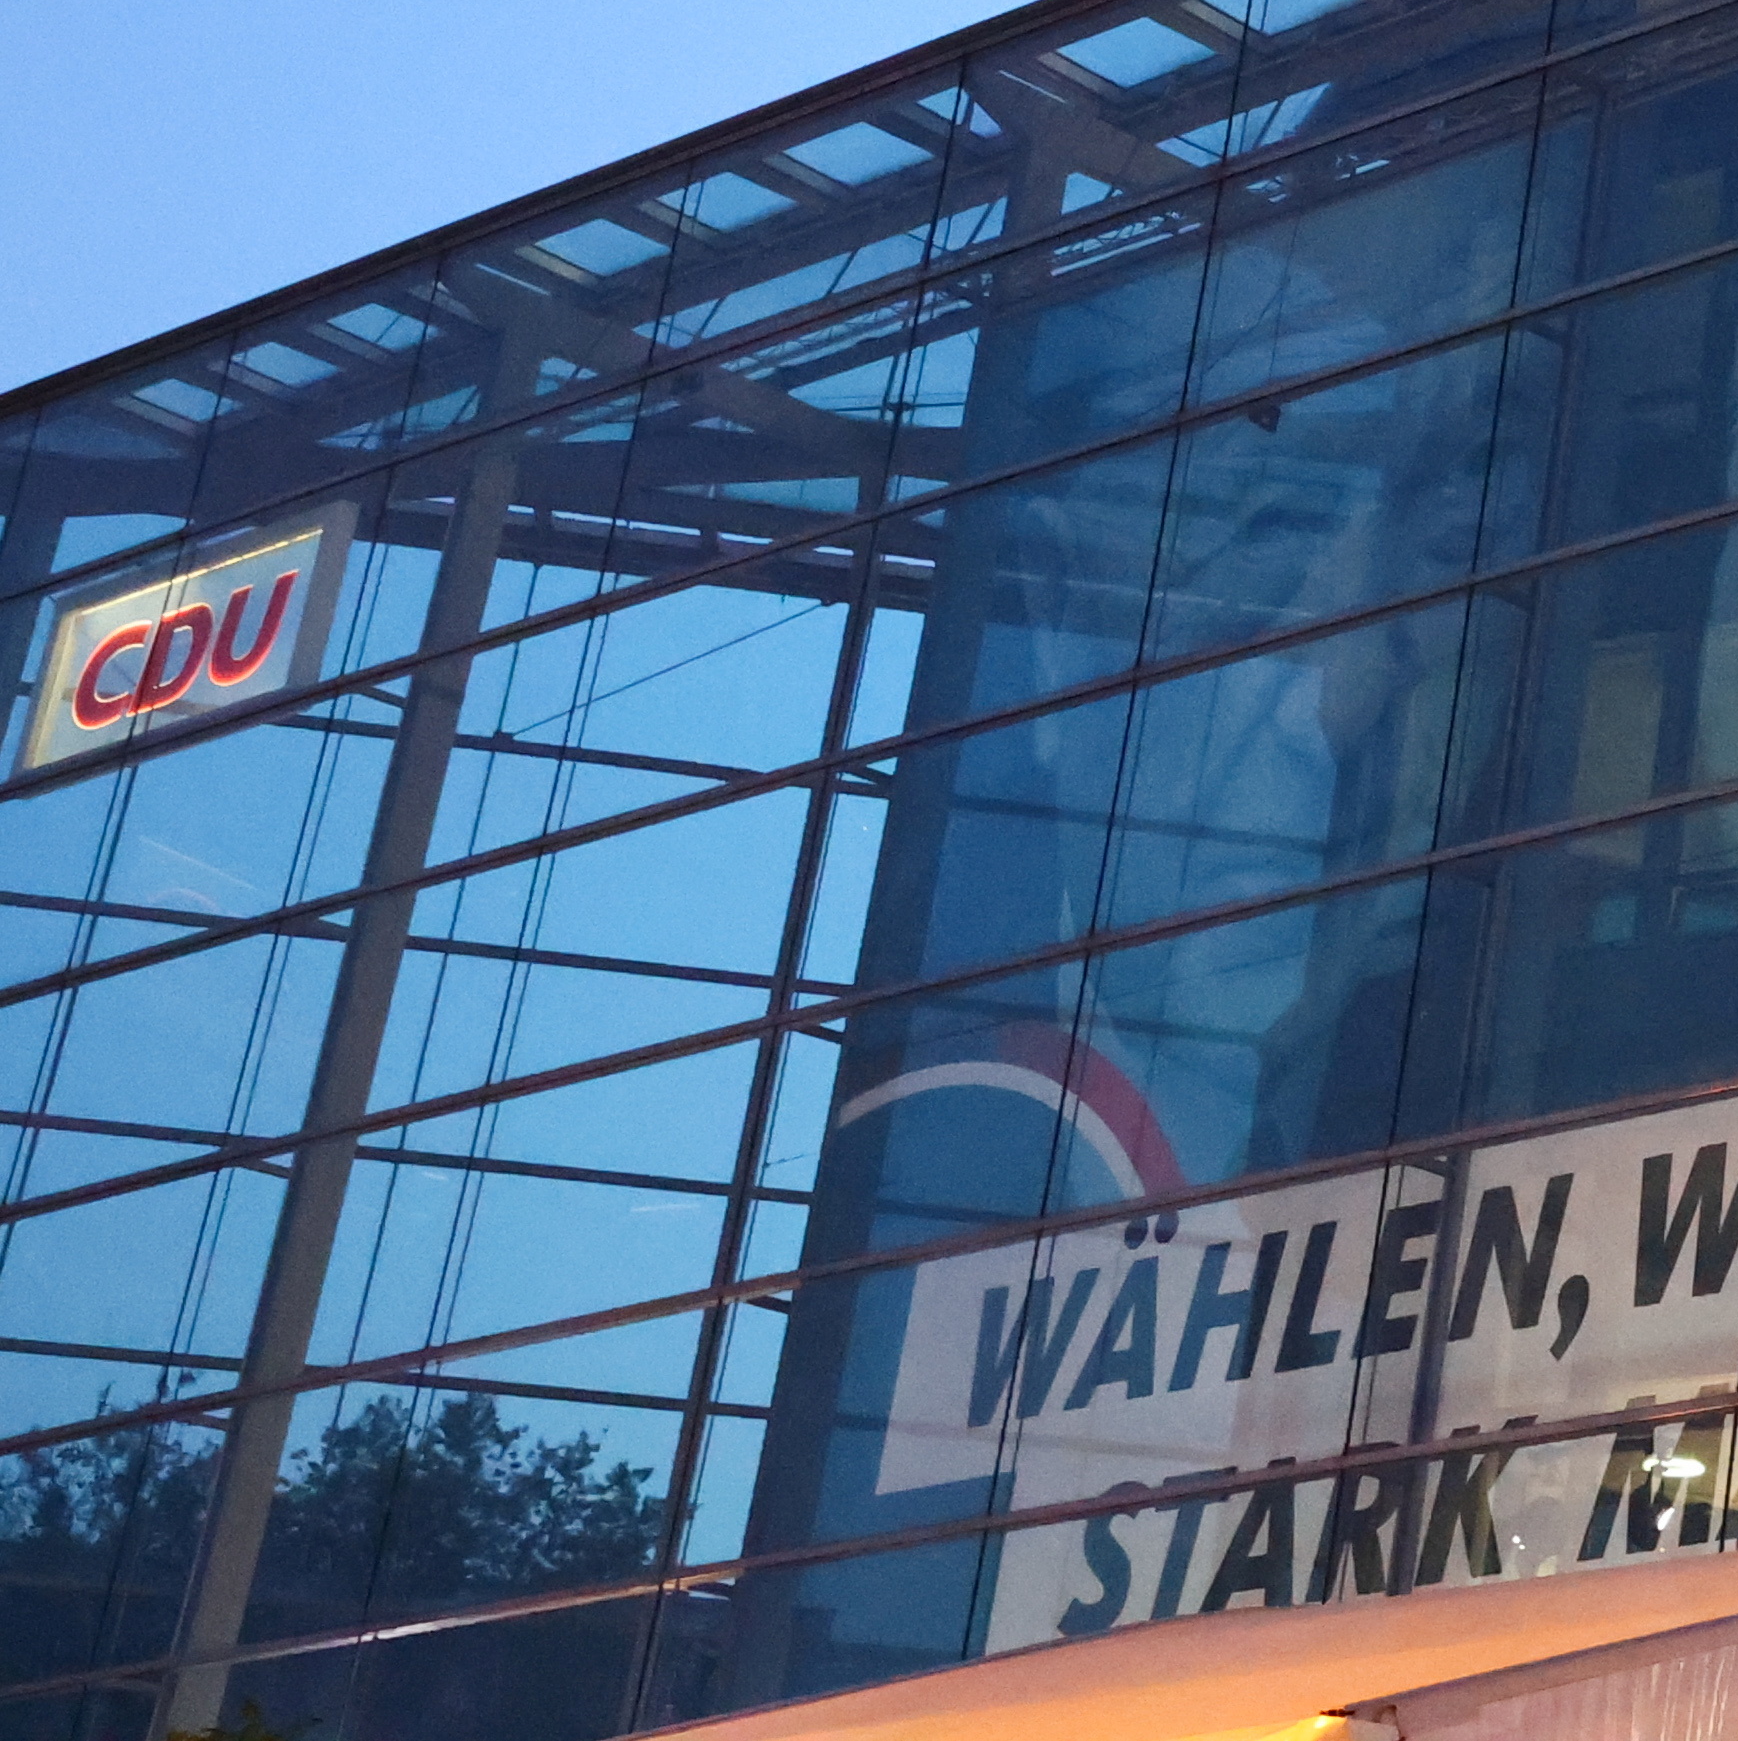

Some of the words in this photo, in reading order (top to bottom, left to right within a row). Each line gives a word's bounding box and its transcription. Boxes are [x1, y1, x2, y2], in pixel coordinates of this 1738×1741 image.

[72, 569, 299, 731] CDU
[966, 1172, 1590, 1428] WÄHLEN,
[1056, 1414, 1540, 1637] STARK
